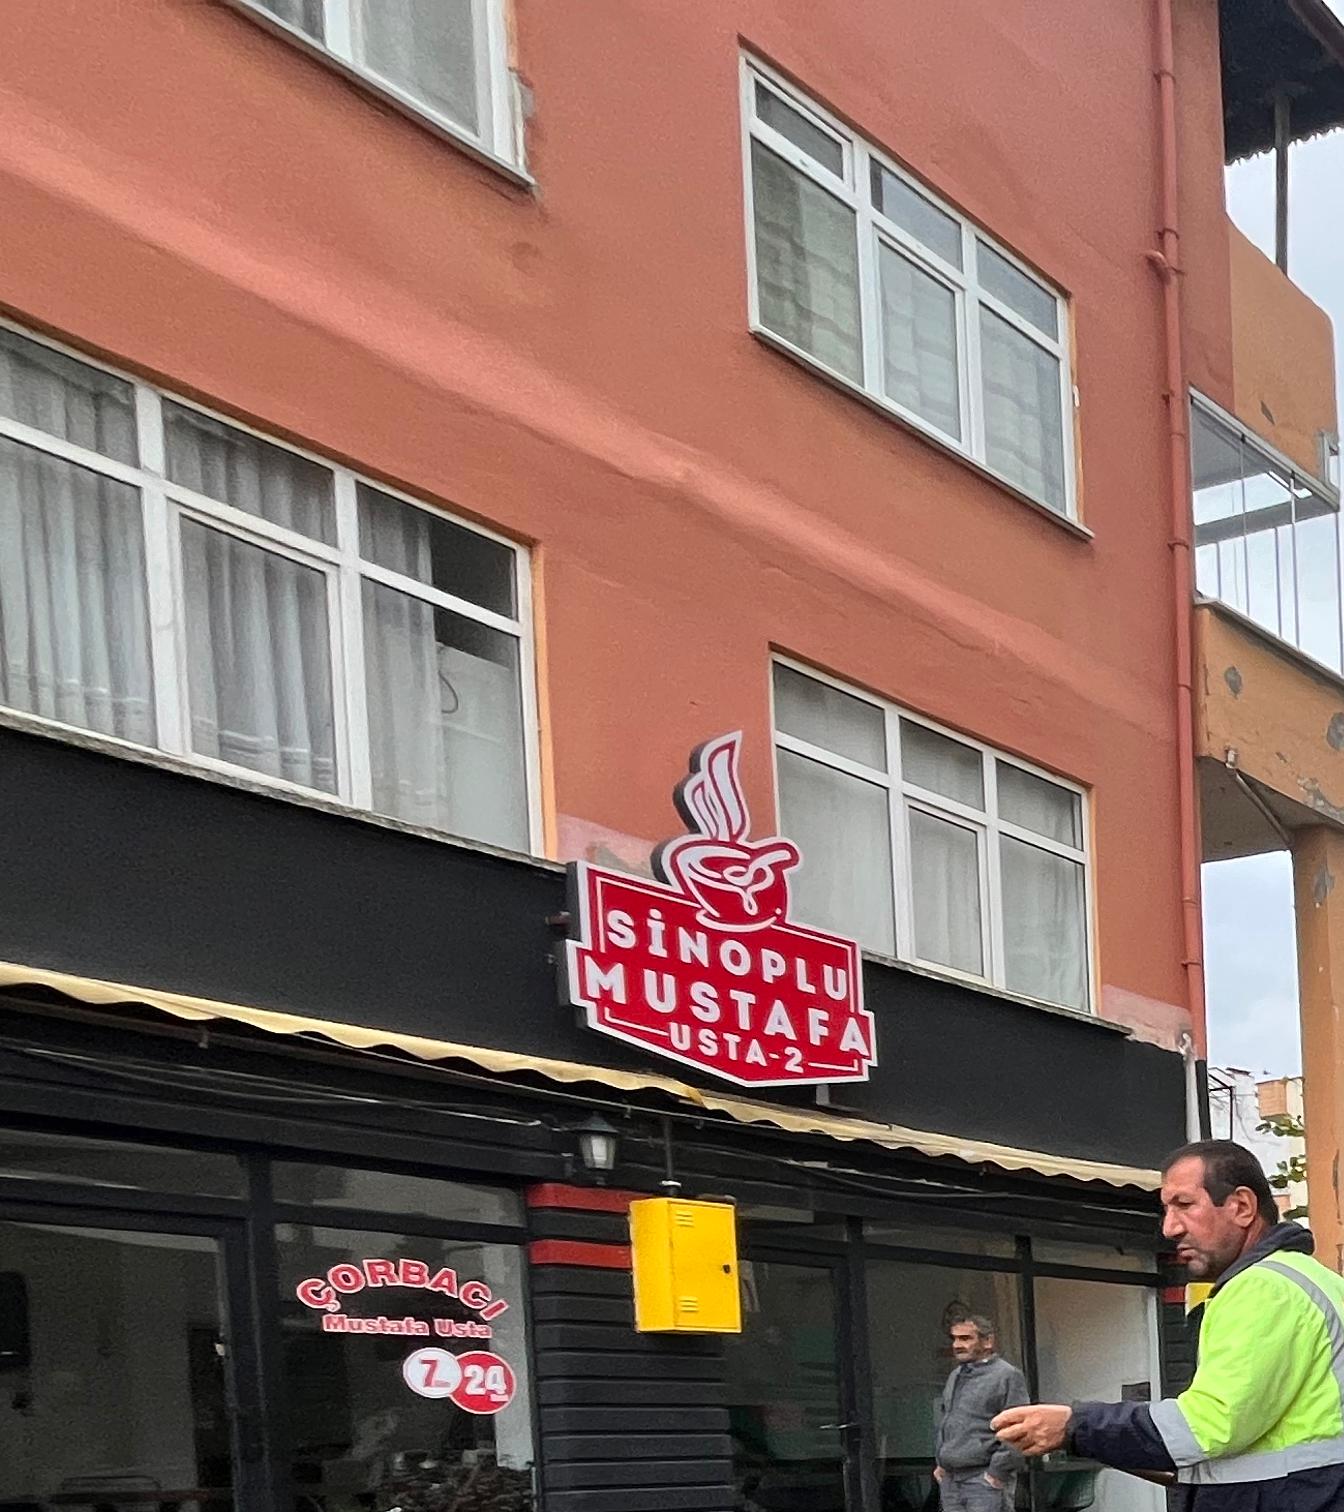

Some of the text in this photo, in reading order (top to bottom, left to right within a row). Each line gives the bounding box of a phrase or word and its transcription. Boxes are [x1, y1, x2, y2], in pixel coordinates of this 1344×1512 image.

[607, 909, 847, 1001] SİNOPLU
[584, 956, 869, 1056] MUSTAFA
[670, 1022, 804, 1073] USTA-2
[297, 1259, 509, 1321] ÇORBACI
[322, 1314, 492, 1338] Mustafa Usta
